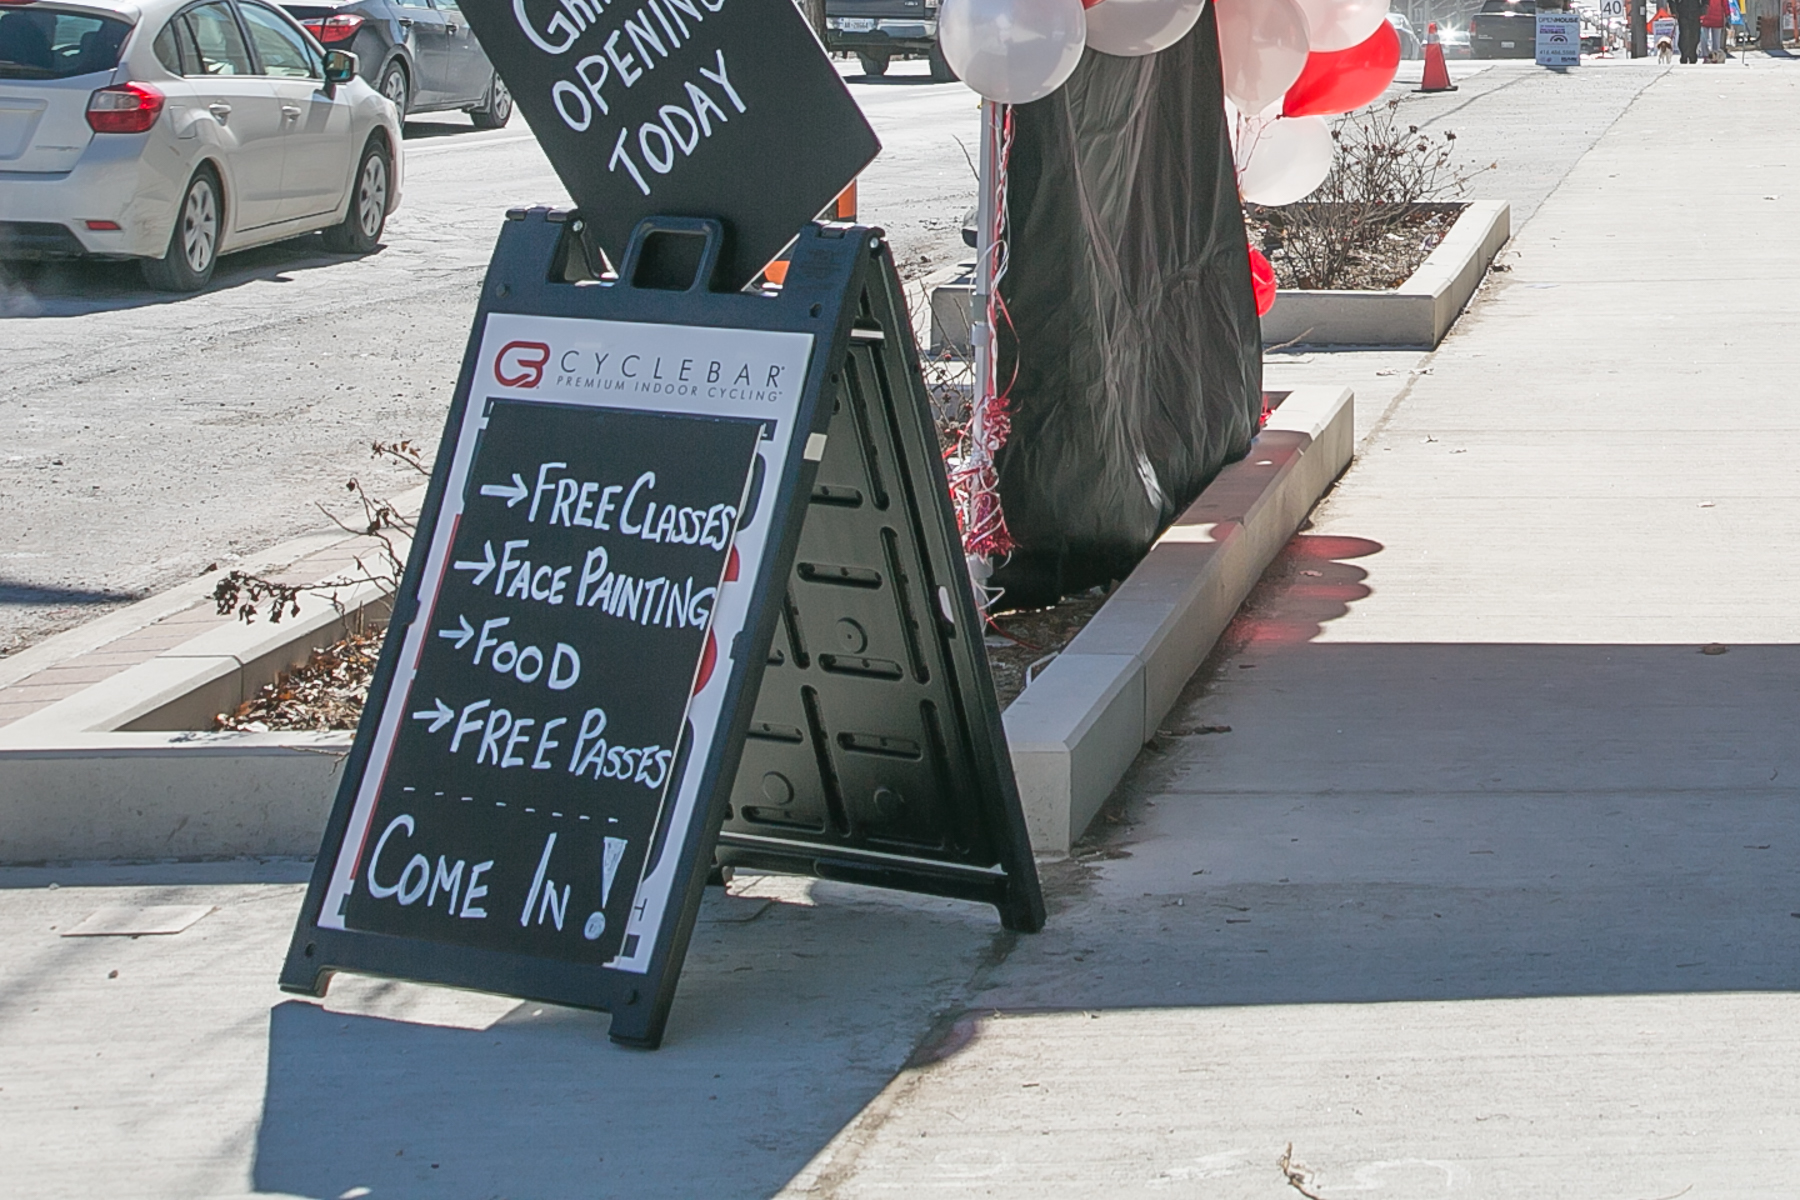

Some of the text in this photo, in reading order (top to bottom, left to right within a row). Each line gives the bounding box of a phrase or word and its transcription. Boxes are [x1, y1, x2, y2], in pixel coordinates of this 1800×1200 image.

[1603, 0, 1622, 16] 40
[608, 49, 747, 197] TODAY
[555, 374, 782, 403] PREMIUM INDOOR CYCLING
[559, 349, 786, 389] CYCLEBAR
[528, 462, 738, 551] FREE CLASSES
[494, 539, 717, 631] FACE PAINTING
[472, 616, 581, 690] FOOD
[449, 698, 672, 790] FREE PASSES
[367, 813, 495, 919] COME
